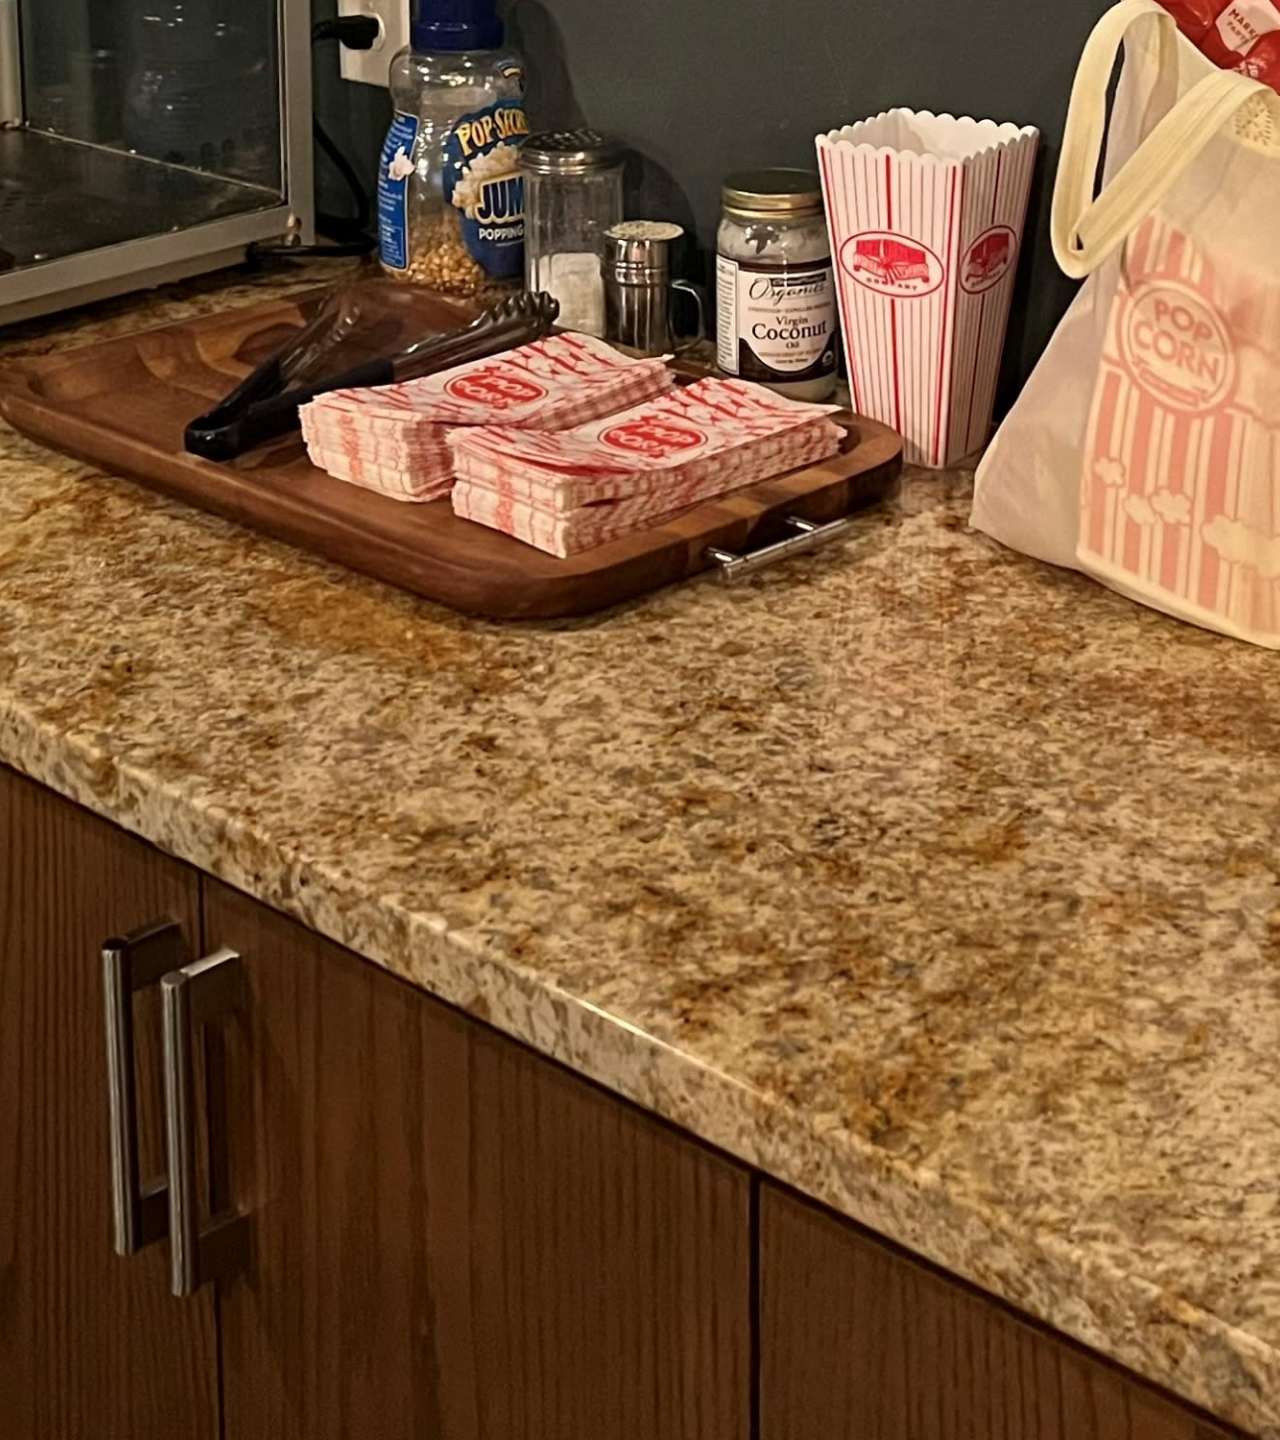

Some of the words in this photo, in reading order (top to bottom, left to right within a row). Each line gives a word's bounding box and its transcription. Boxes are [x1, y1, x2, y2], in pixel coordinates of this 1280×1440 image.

[476, 175, 524, 222] JUM
[478, 223, 524, 240] POPPING
[752, 320, 827, 340] Coconut
[776, 315, 809, 328] Virgin
[1154, 299, 1213, 341] POP
[785, 341, 800, 349] Oil
[1133, 321, 1219, 384] CORN
[482, 377, 537, 397] POP
[636, 425, 695, 443] POP
